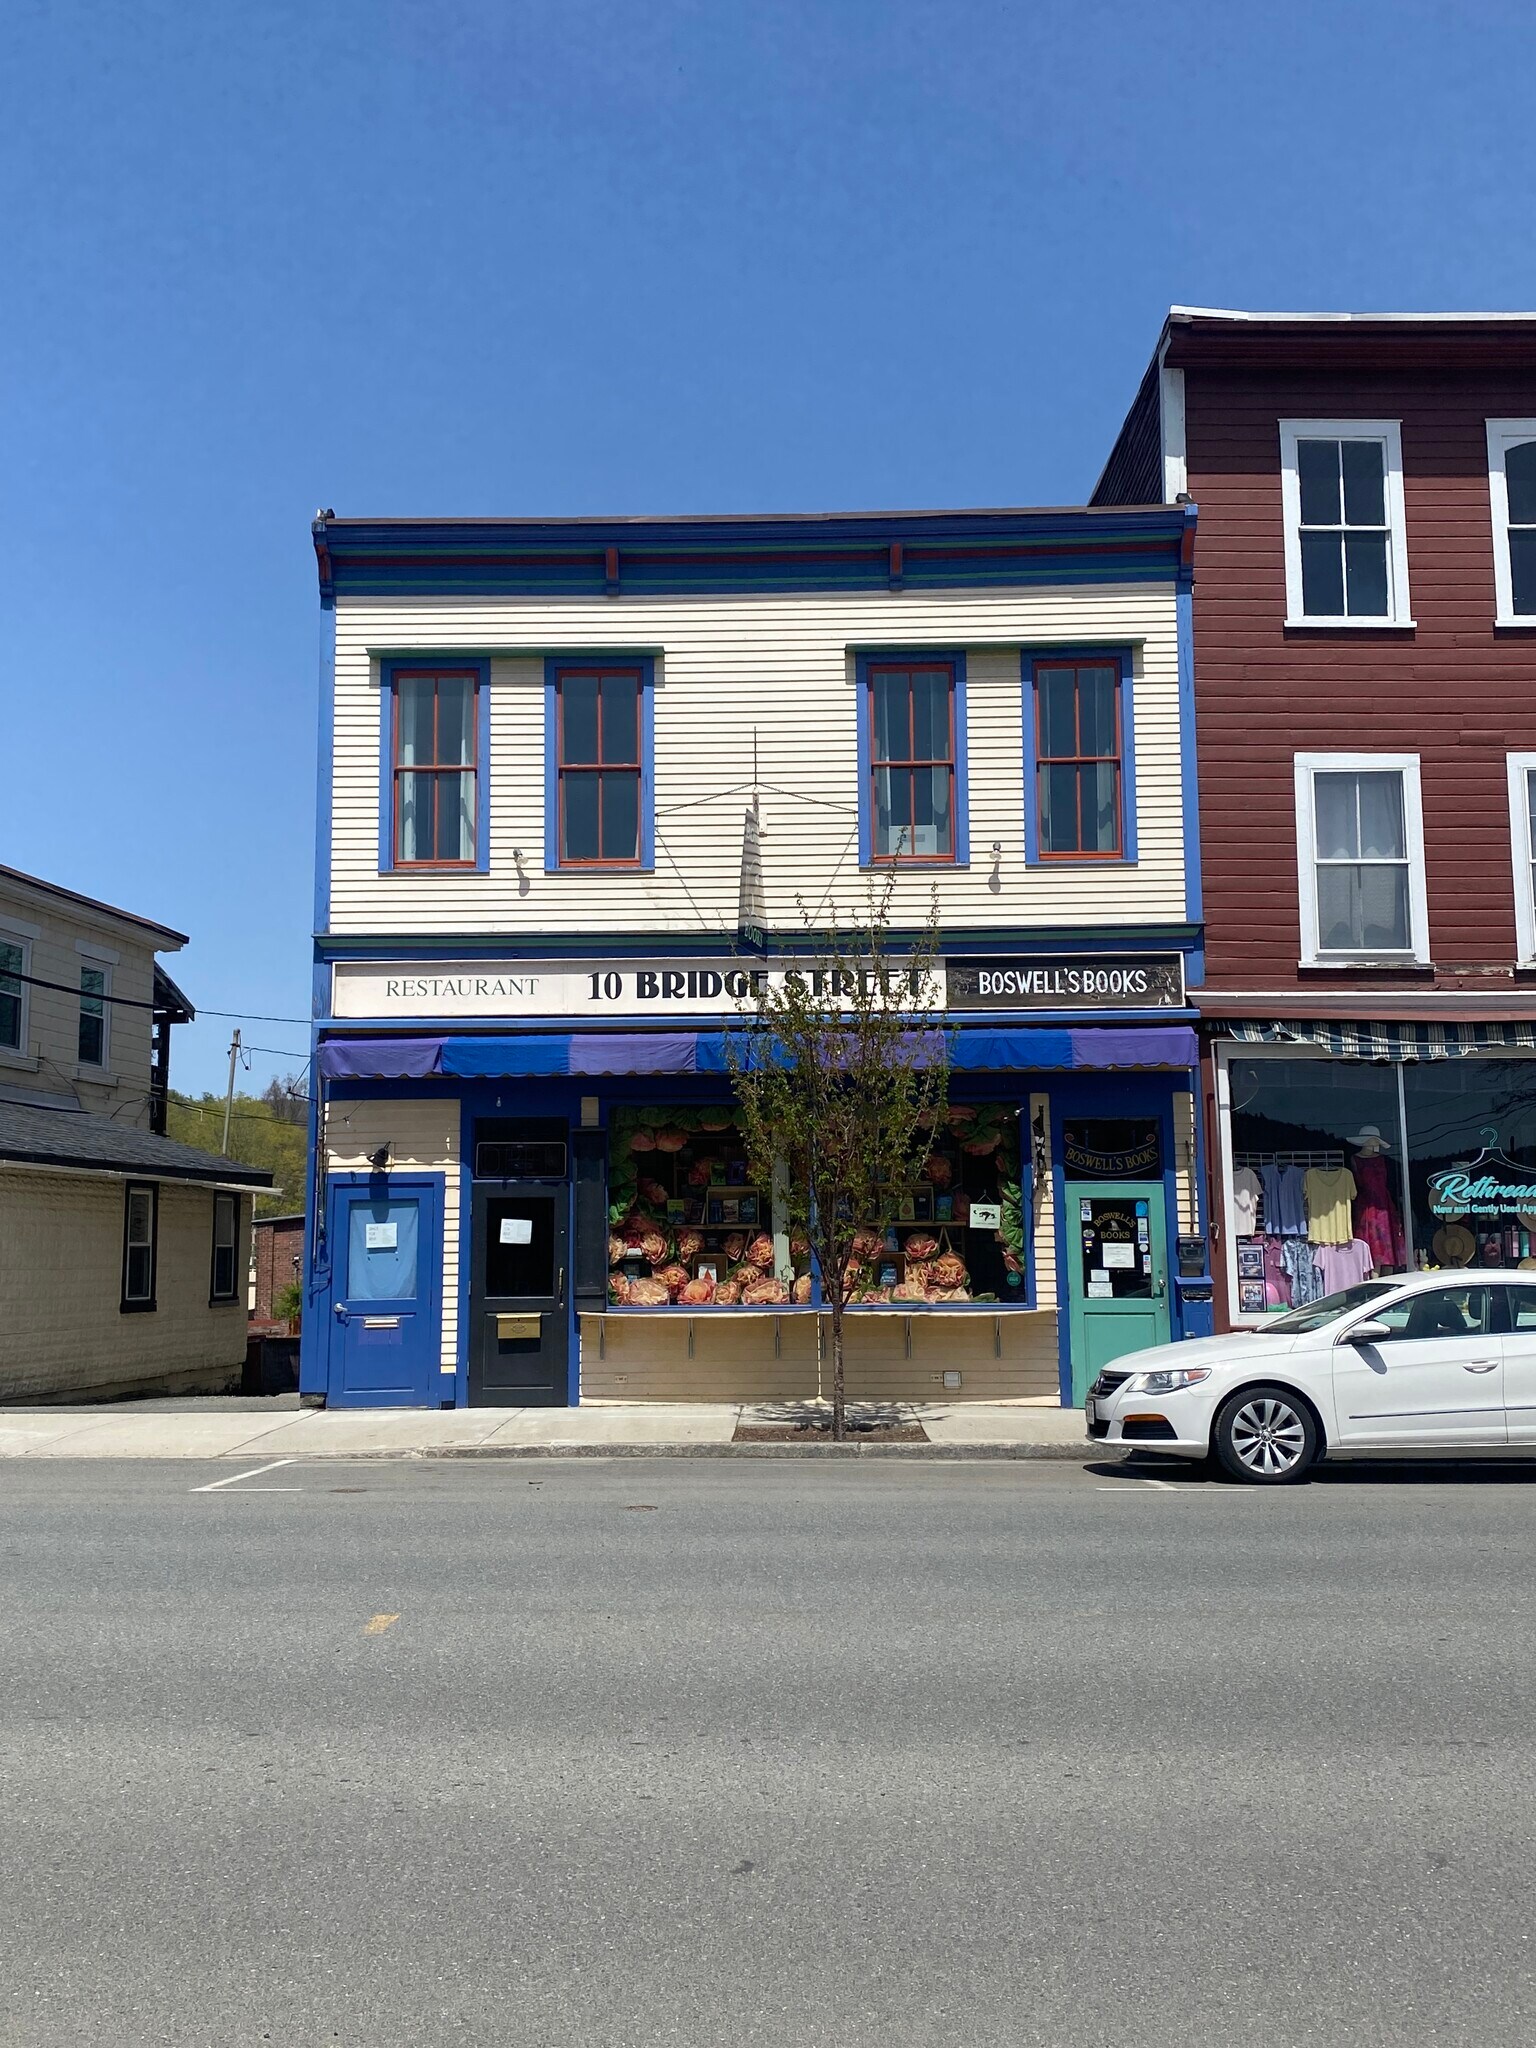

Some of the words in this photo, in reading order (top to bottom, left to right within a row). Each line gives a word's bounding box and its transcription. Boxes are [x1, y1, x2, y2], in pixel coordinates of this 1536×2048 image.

[385, 977, 540, 998] RESTAURANT
[588, 971, 622, 1000] 10
[638, 970, 768, 998] BRIDGE
[978, 968, 1080, 994] BOSWELL'S
[1083, 970, 1148, 993] BOOKS
[1066, 1147, 1123, 1171] BOSWELL'S
[1125, 1146, 1158, 1169] BOOKS
[1093, 1212, 1136, 1227] BOSWELL'S
[1433, 1205, 1452, 1213] New
[1454, 1204, 1470, 1213] and
[1471, 1204, 1499, 1215] Gently
[1500, 1204, 1520, 1213] Used
[1100, 1231, 1130, 1239] BOOKS
